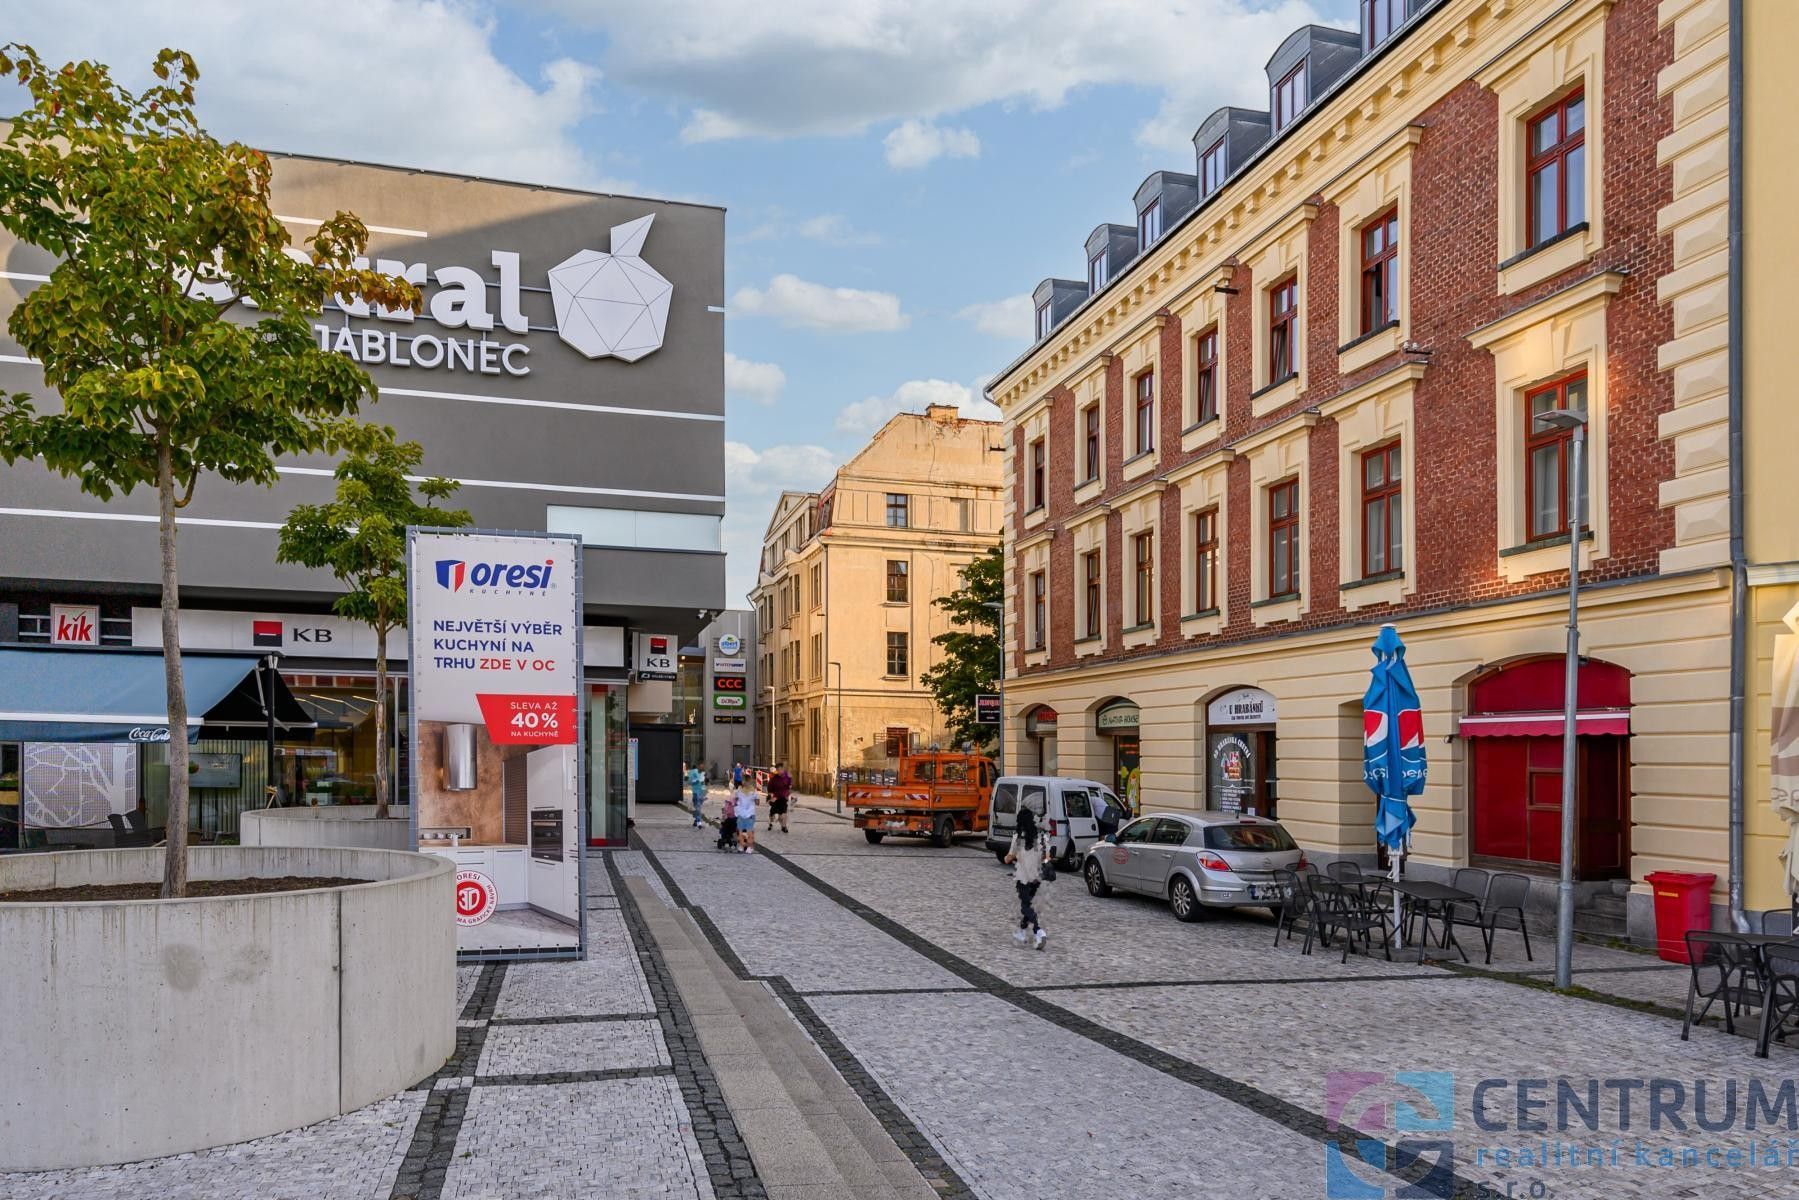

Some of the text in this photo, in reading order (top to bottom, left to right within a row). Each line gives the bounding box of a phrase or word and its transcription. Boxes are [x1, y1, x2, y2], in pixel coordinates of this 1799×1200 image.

[315, 325, 531, 377] JABLONEC
[470, 559, 554, 589] oresi
[57, 611, 93, 641] kik
[433, 618, 562, 636] NEJVĚTŠÍ VÝBĚR
[293, 628, 333, 643] KB
[433, 637, 535, 653] KUCHYNÍ NA
[433, 656, 555, 671] TRHU ZDE V OC
[646, 658, 670, 668] KB
[718, 679, 742, 689] CCC
[510, 701, 558, 710] SLEVA AŽ
[457, 872, 481, 881] ORESI
[458, 886, 480, 911] 3D
